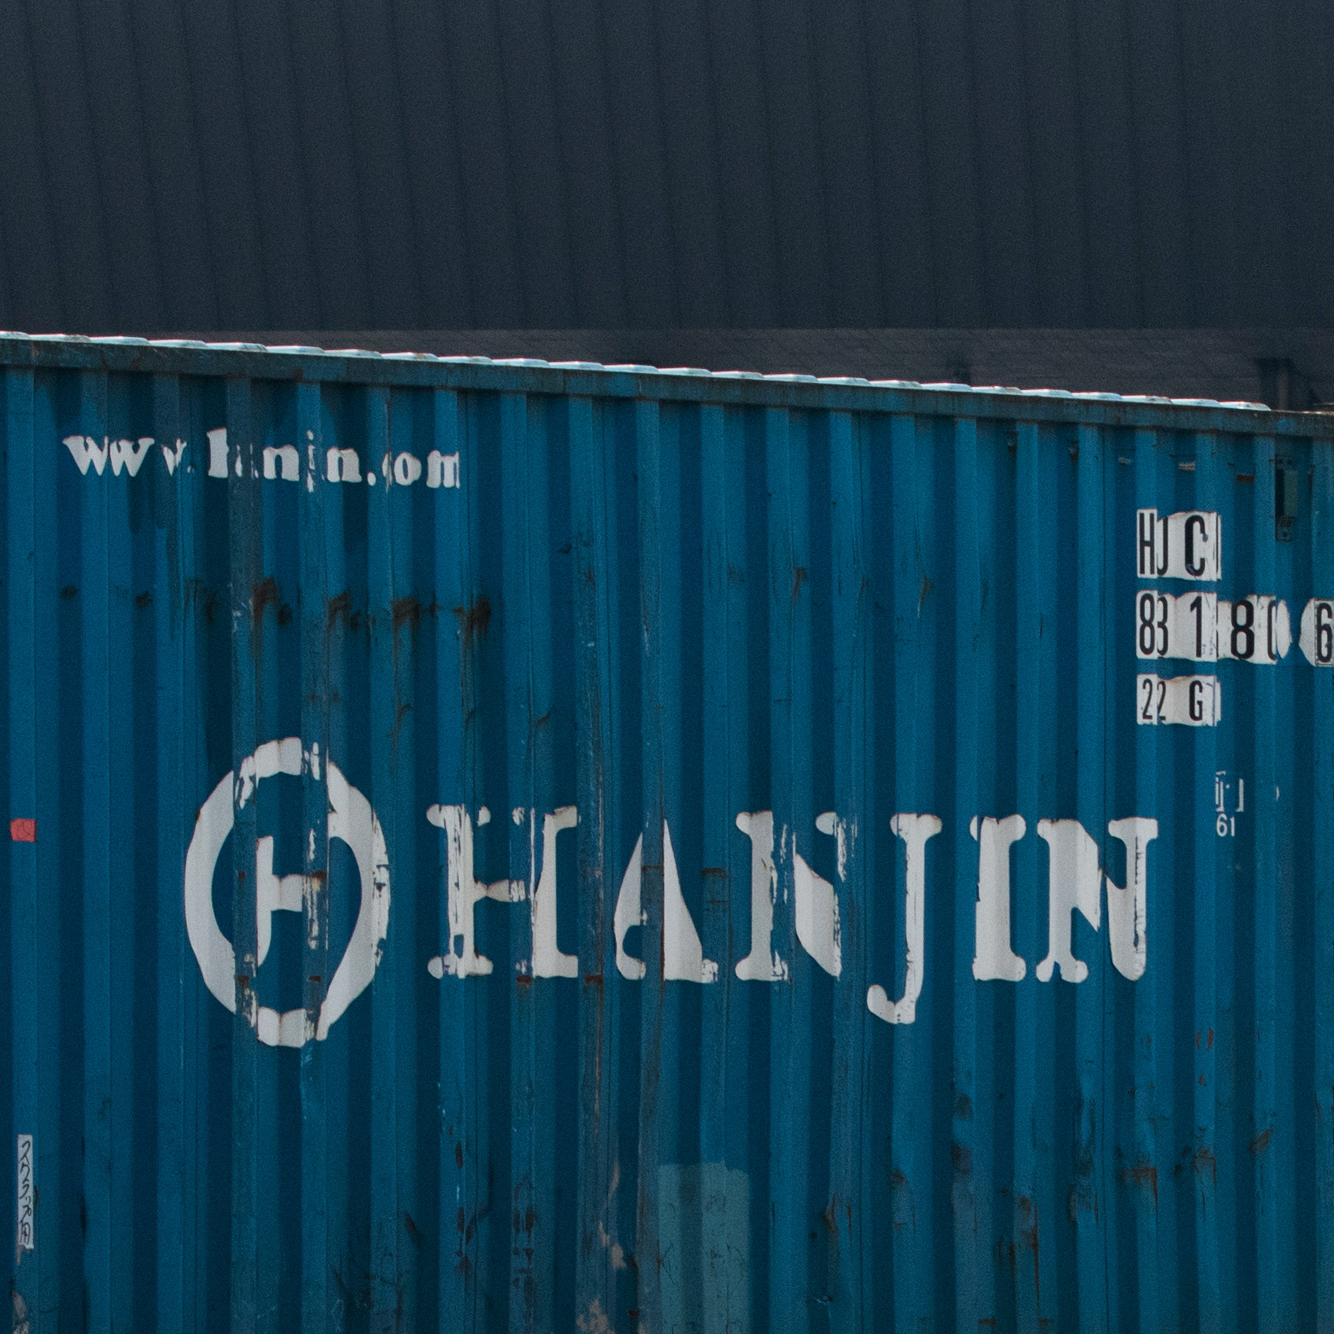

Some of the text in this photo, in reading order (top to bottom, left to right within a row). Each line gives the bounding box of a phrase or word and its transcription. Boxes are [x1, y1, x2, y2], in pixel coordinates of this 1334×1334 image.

[1140, 513, 1217, 575] HJC
[1142, 678, 1215, 721] 22G
[426, 804, 1158, 1024] HANJIN
